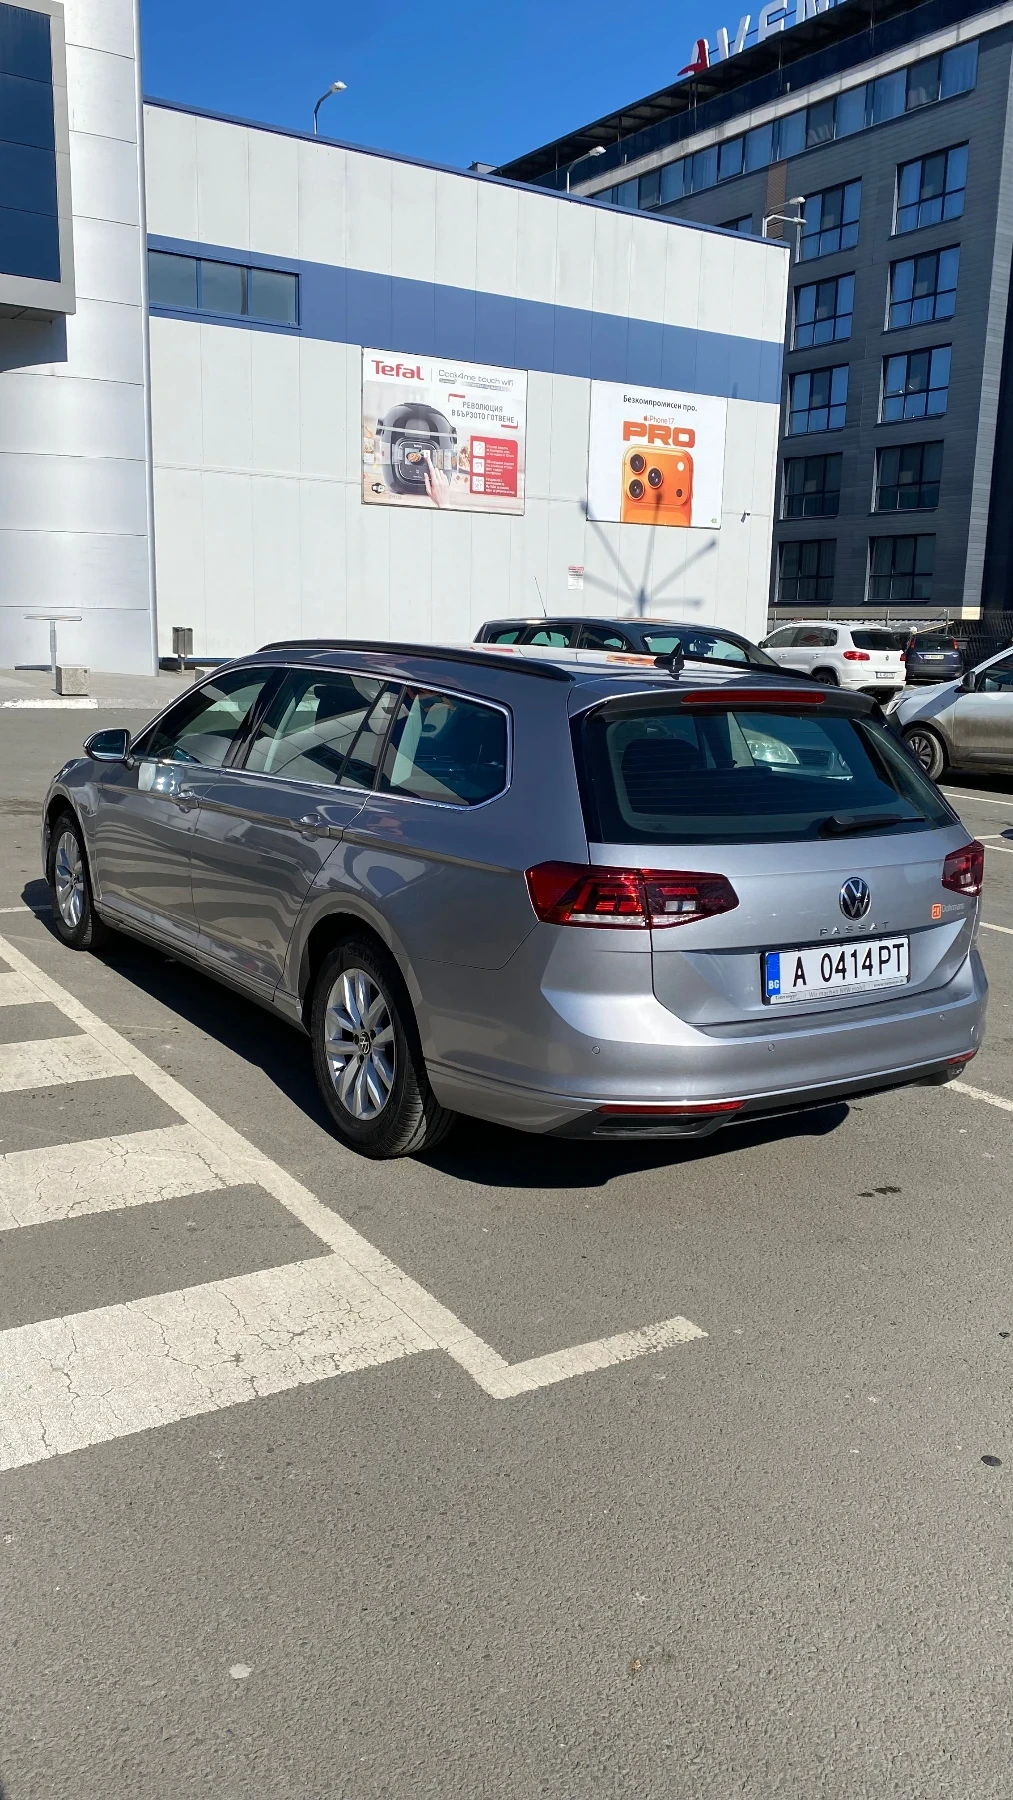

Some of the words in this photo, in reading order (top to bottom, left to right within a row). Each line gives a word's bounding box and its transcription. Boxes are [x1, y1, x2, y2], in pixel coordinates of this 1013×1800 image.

[677, 0, 848, 76] AVE
[371, 359, 425, 381] Tefal
[462, 401, 503, 413] РЕВОЛЮЦИЯ
[623, 394, 682, 410] Безкомпромисен
[682, 403, 698, 412] про.
[456, 409, 486, 420] БЪРЗОТО
[486, 414, 515, 424] ГОТВЕНЕ
[622, 420, 696, 449] PRO
[819, 921, 890, 937] PASSAT
[792, 956, 807, 988] A
[820, 942, 905, 983] 0414PT
[768, 979, 780, 990] BG
